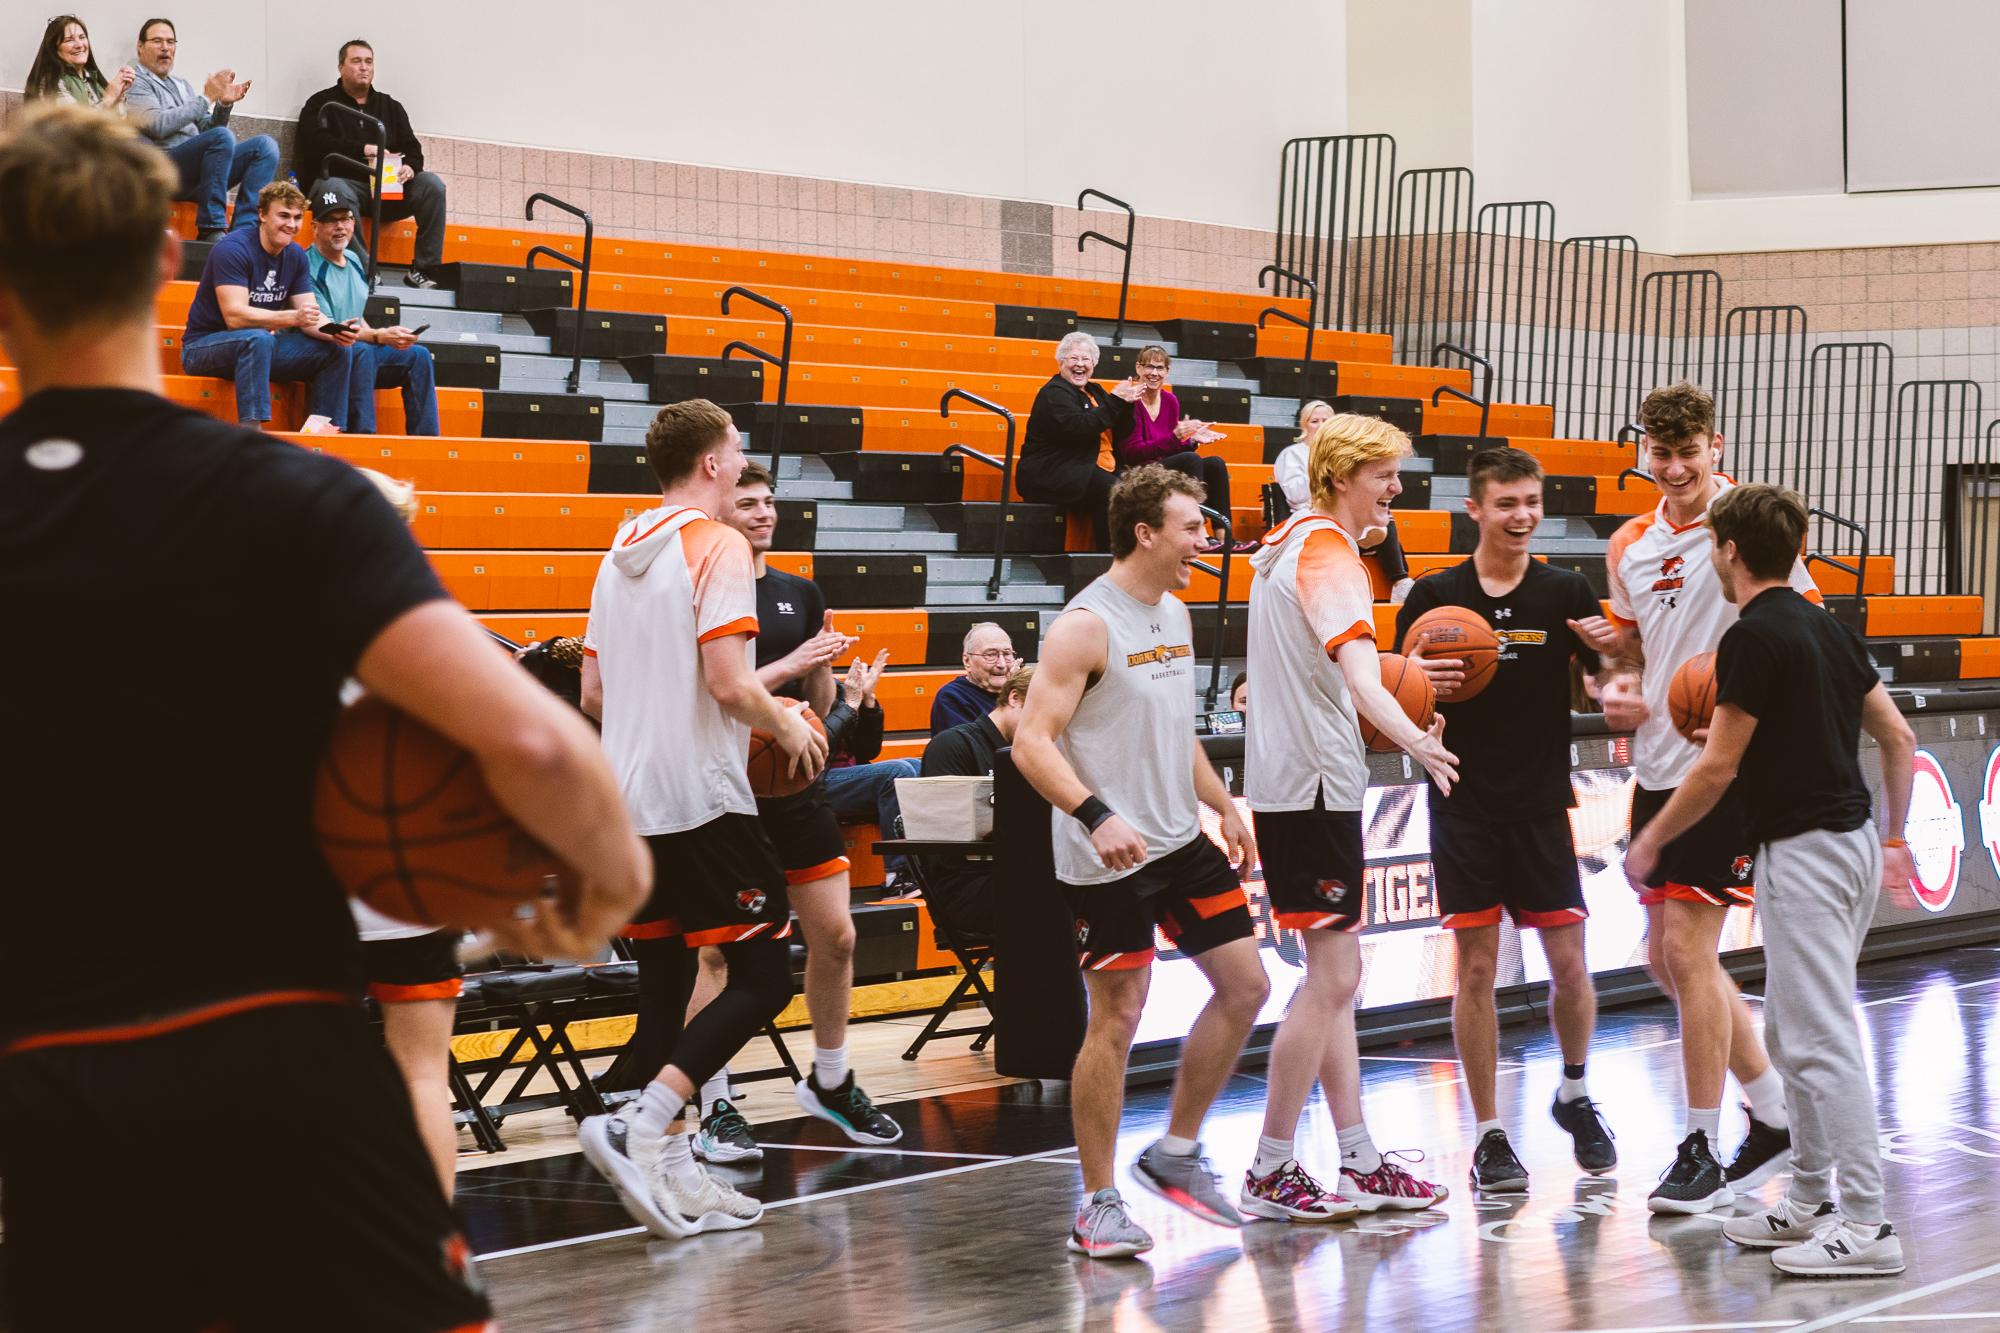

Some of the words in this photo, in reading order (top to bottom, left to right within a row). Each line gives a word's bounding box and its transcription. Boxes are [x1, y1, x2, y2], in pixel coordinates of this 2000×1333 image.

[1127, 650, 1156, 668] DOANE
[1607, 740, 1616, 763] P
[1402, 755, 1413, 779] B
[1223, 766, 1234, 792] P
[1360, 862, 1441, 927] TIGE
[1822, 1239, 1851, 1260] N
